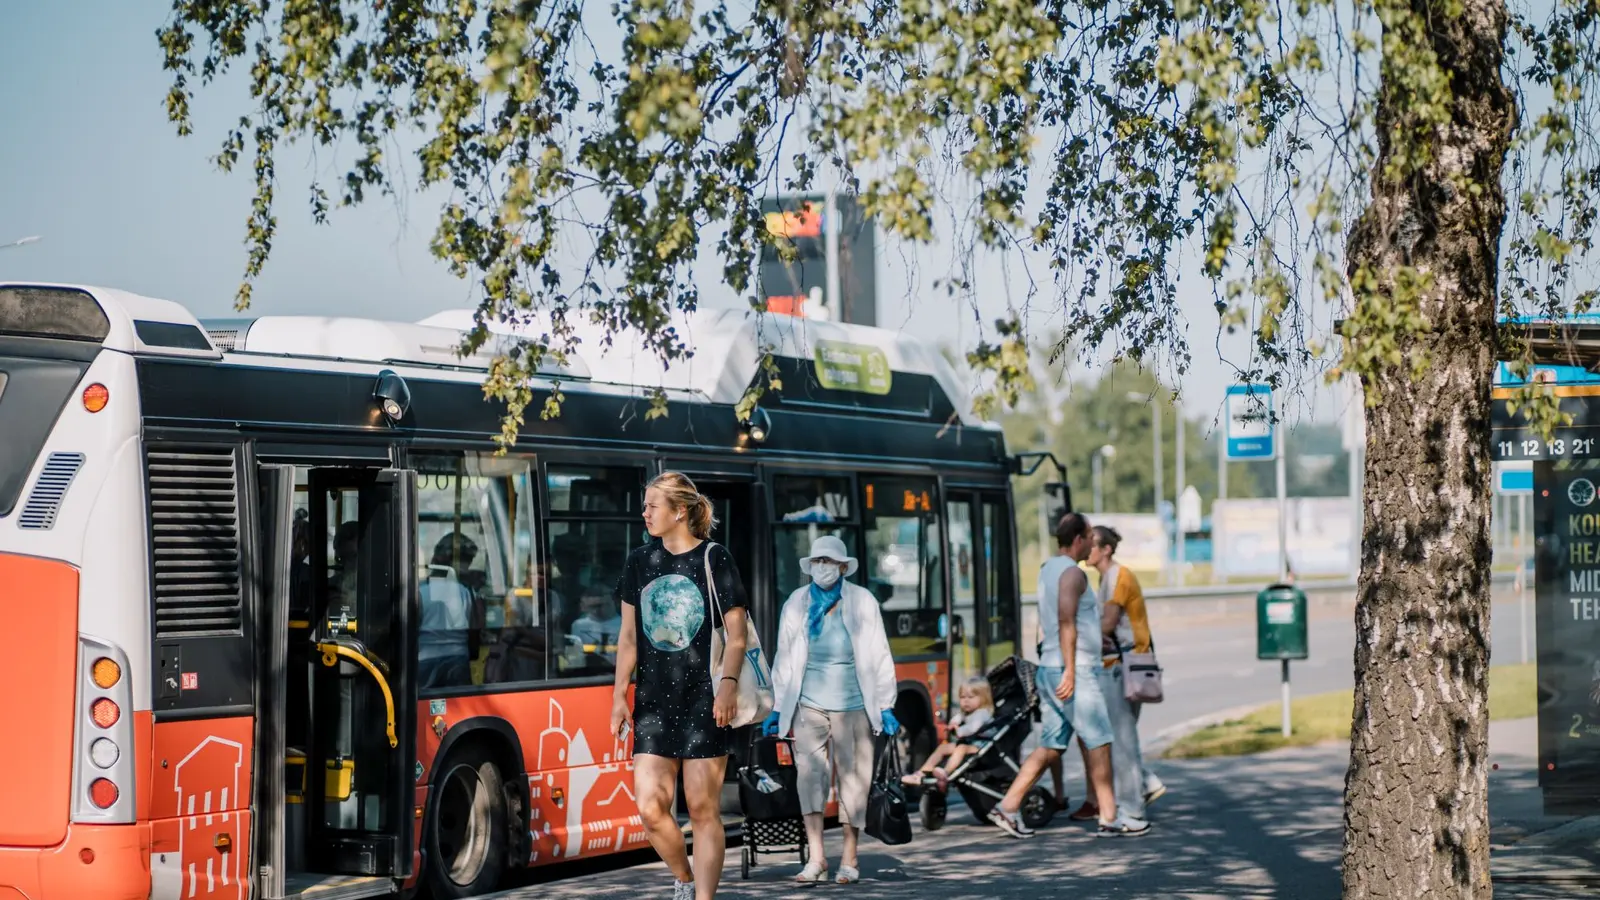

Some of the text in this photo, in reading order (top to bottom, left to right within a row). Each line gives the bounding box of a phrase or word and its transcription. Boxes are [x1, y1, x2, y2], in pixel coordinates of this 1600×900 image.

[1498, 440, 1513, 456] 11
[1521, 440, 1540, 456] 12
[1546, 439, 1565, 455] 13
